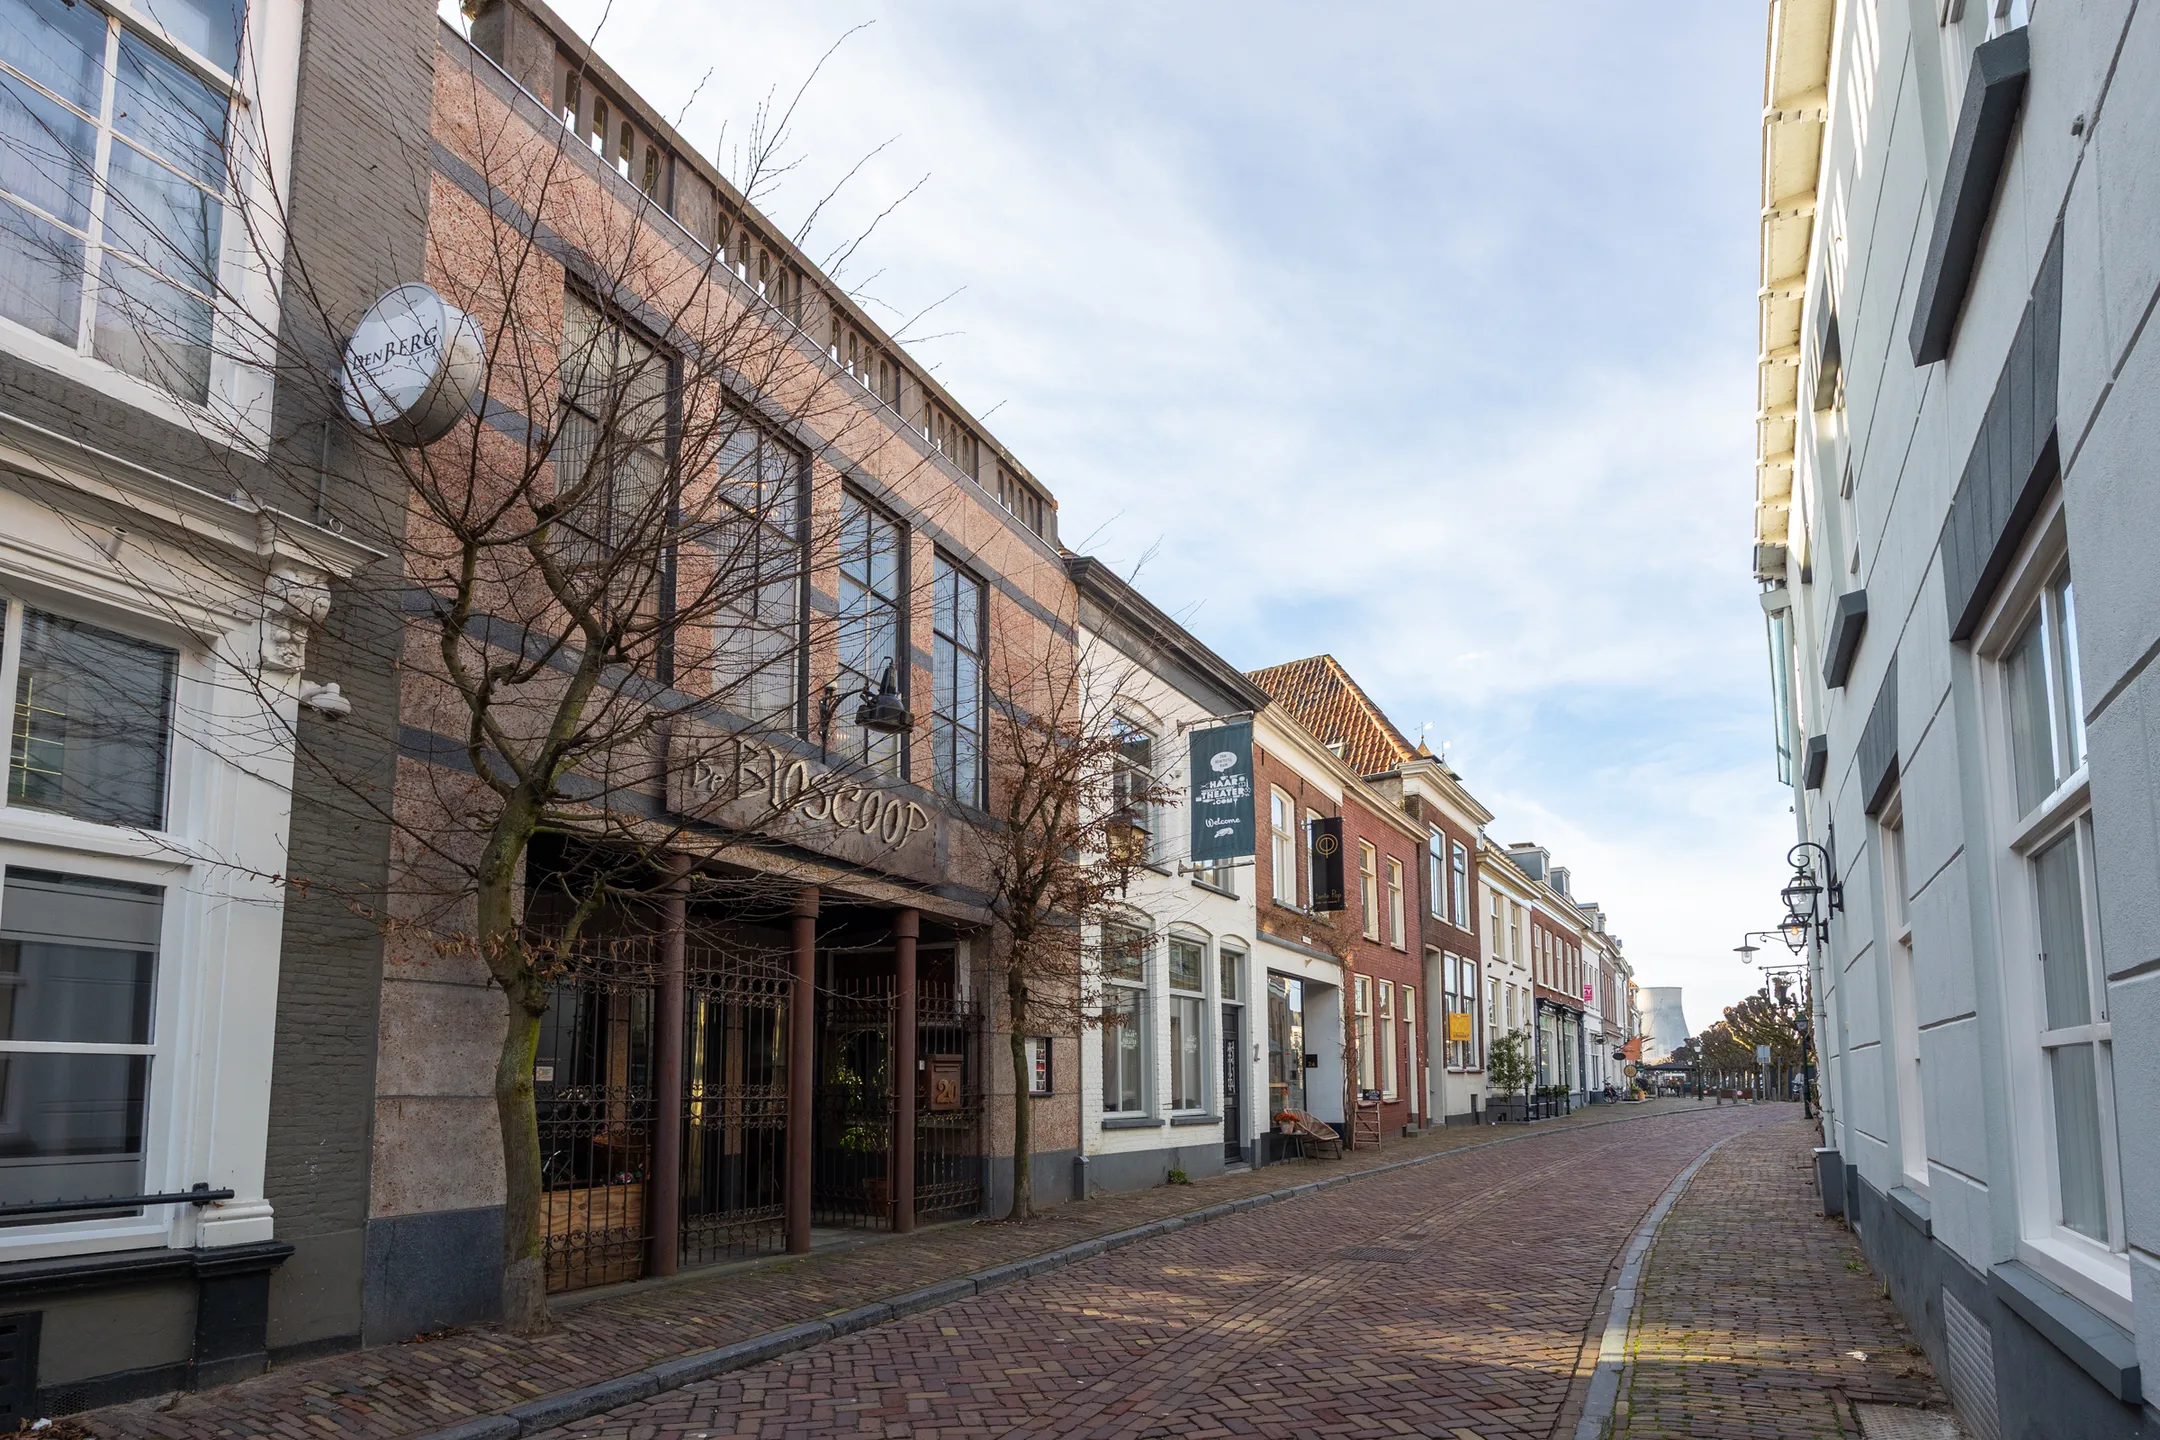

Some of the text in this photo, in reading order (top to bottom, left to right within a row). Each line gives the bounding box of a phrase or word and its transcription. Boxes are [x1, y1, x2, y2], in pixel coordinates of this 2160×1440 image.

[1209, 778, 1238, 789] HAAR
[1201, 787, 1245, 800] THEATER
[1205, 817, 1241, 828] Welcome
[937, 1079, 958, 1103] 20
